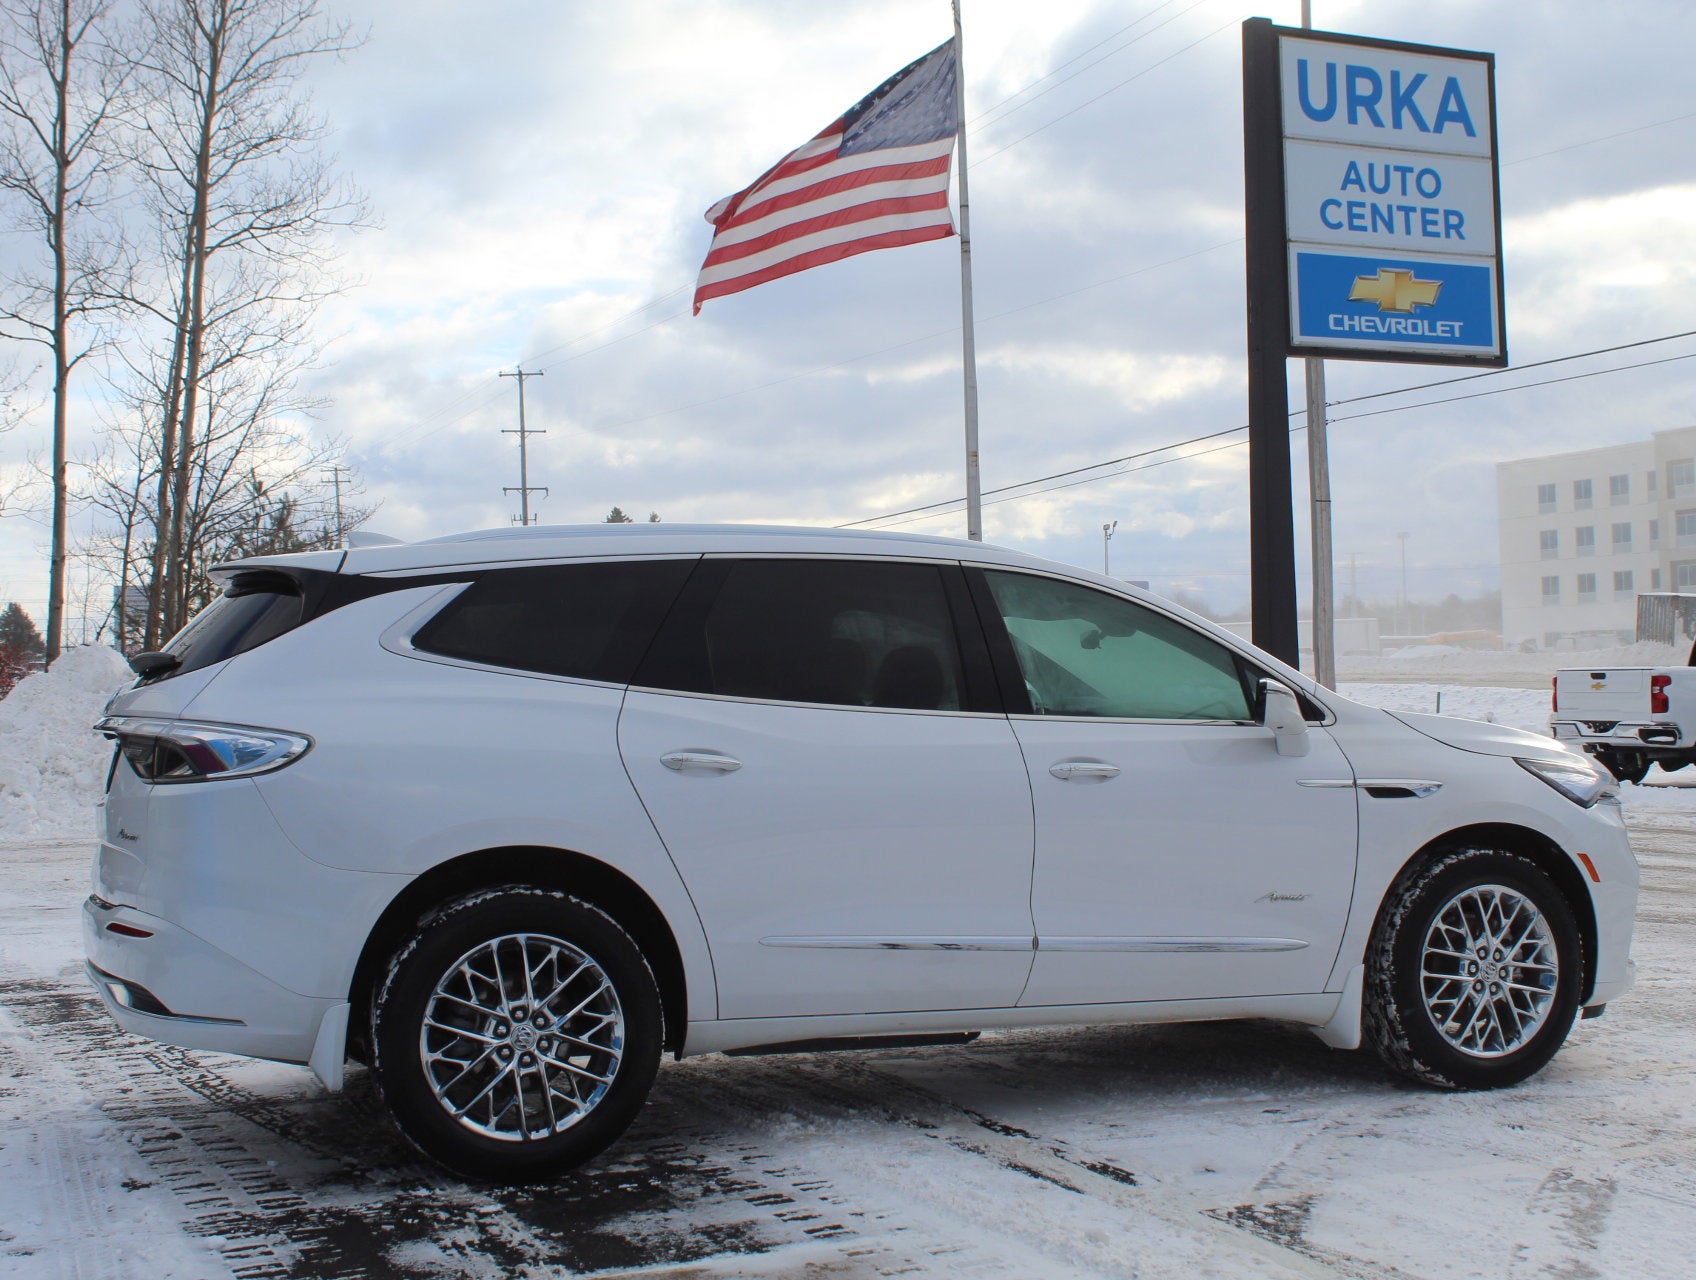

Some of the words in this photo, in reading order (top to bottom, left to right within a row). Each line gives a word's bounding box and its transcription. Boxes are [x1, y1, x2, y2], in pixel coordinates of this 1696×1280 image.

[1297, 58, 1477, 138] URKA
[1340, 160, 1442, 199] AUTO
[1319, 198, 1466, 241] CENTER
[1328, 313, 1464, 338] CHEVROLET
